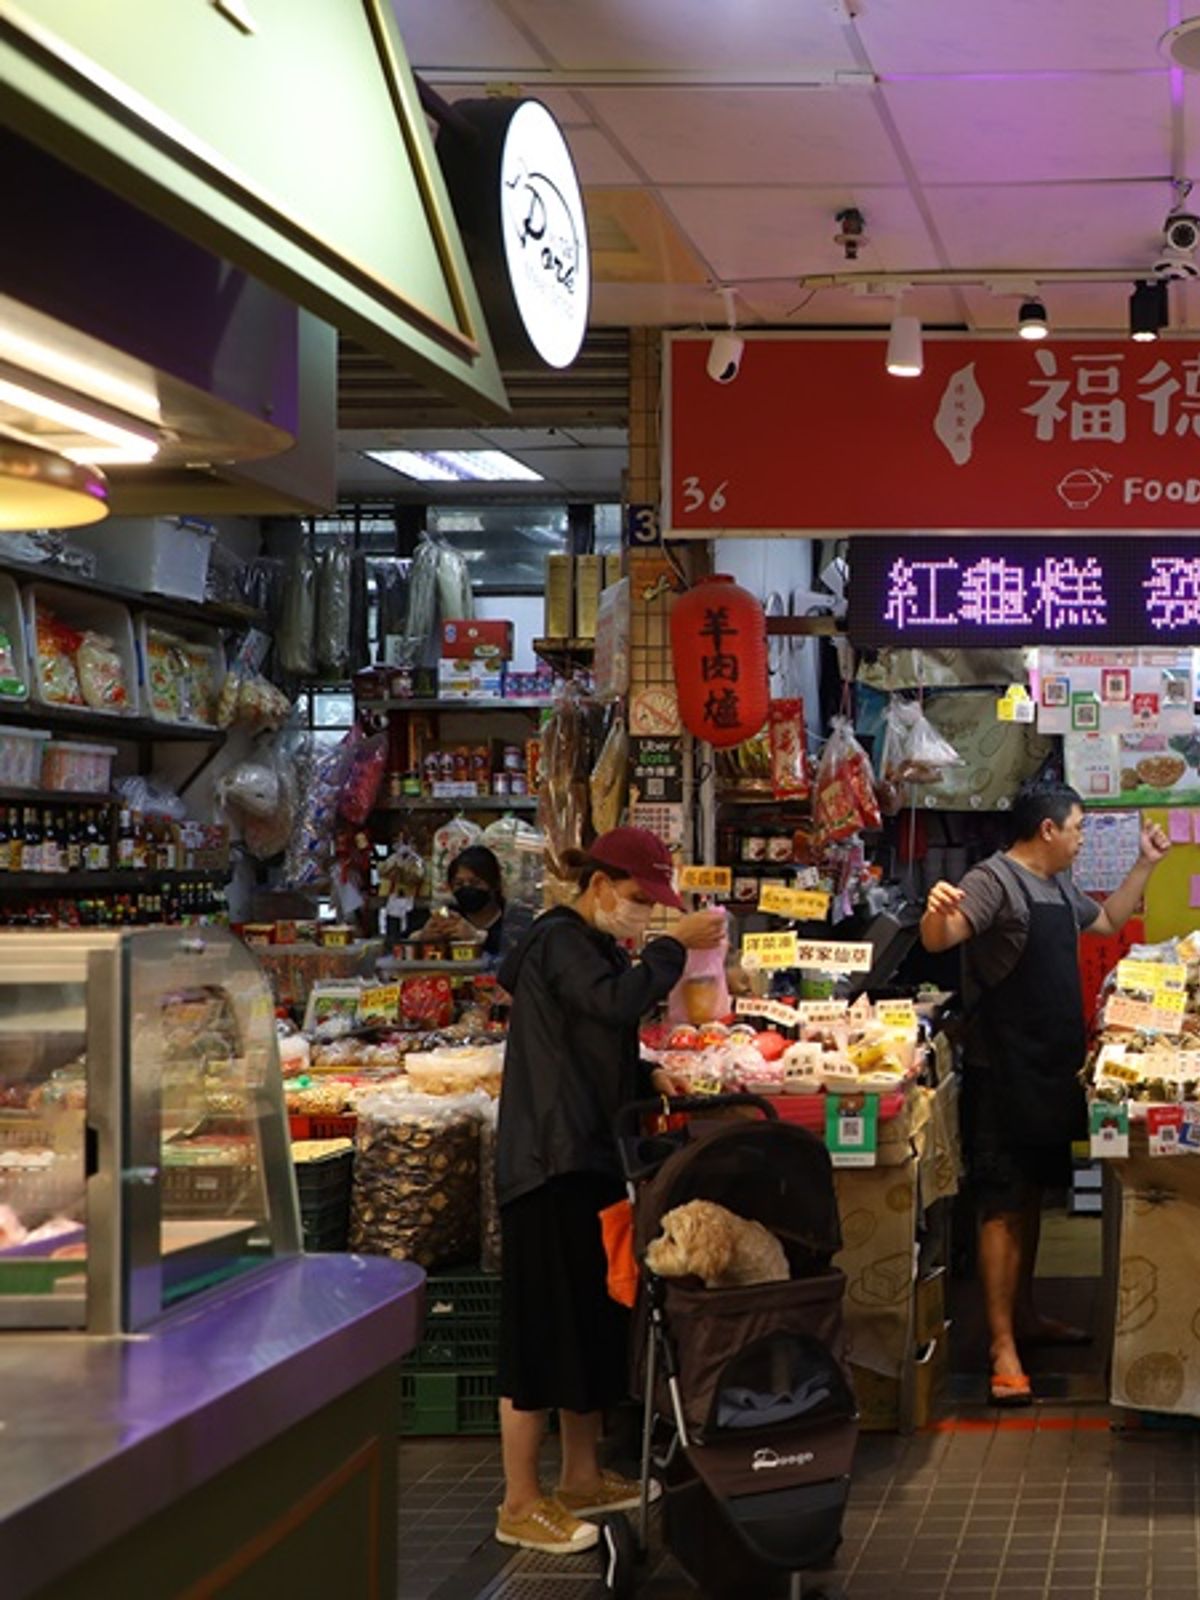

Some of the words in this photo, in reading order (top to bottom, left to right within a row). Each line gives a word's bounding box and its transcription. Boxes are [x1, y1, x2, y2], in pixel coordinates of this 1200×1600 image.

[682, 476, 729, 513] 36
[884, 556, 1107, 629] 紅龜糕
[698, 605, 742, 730] 羊肉爐
